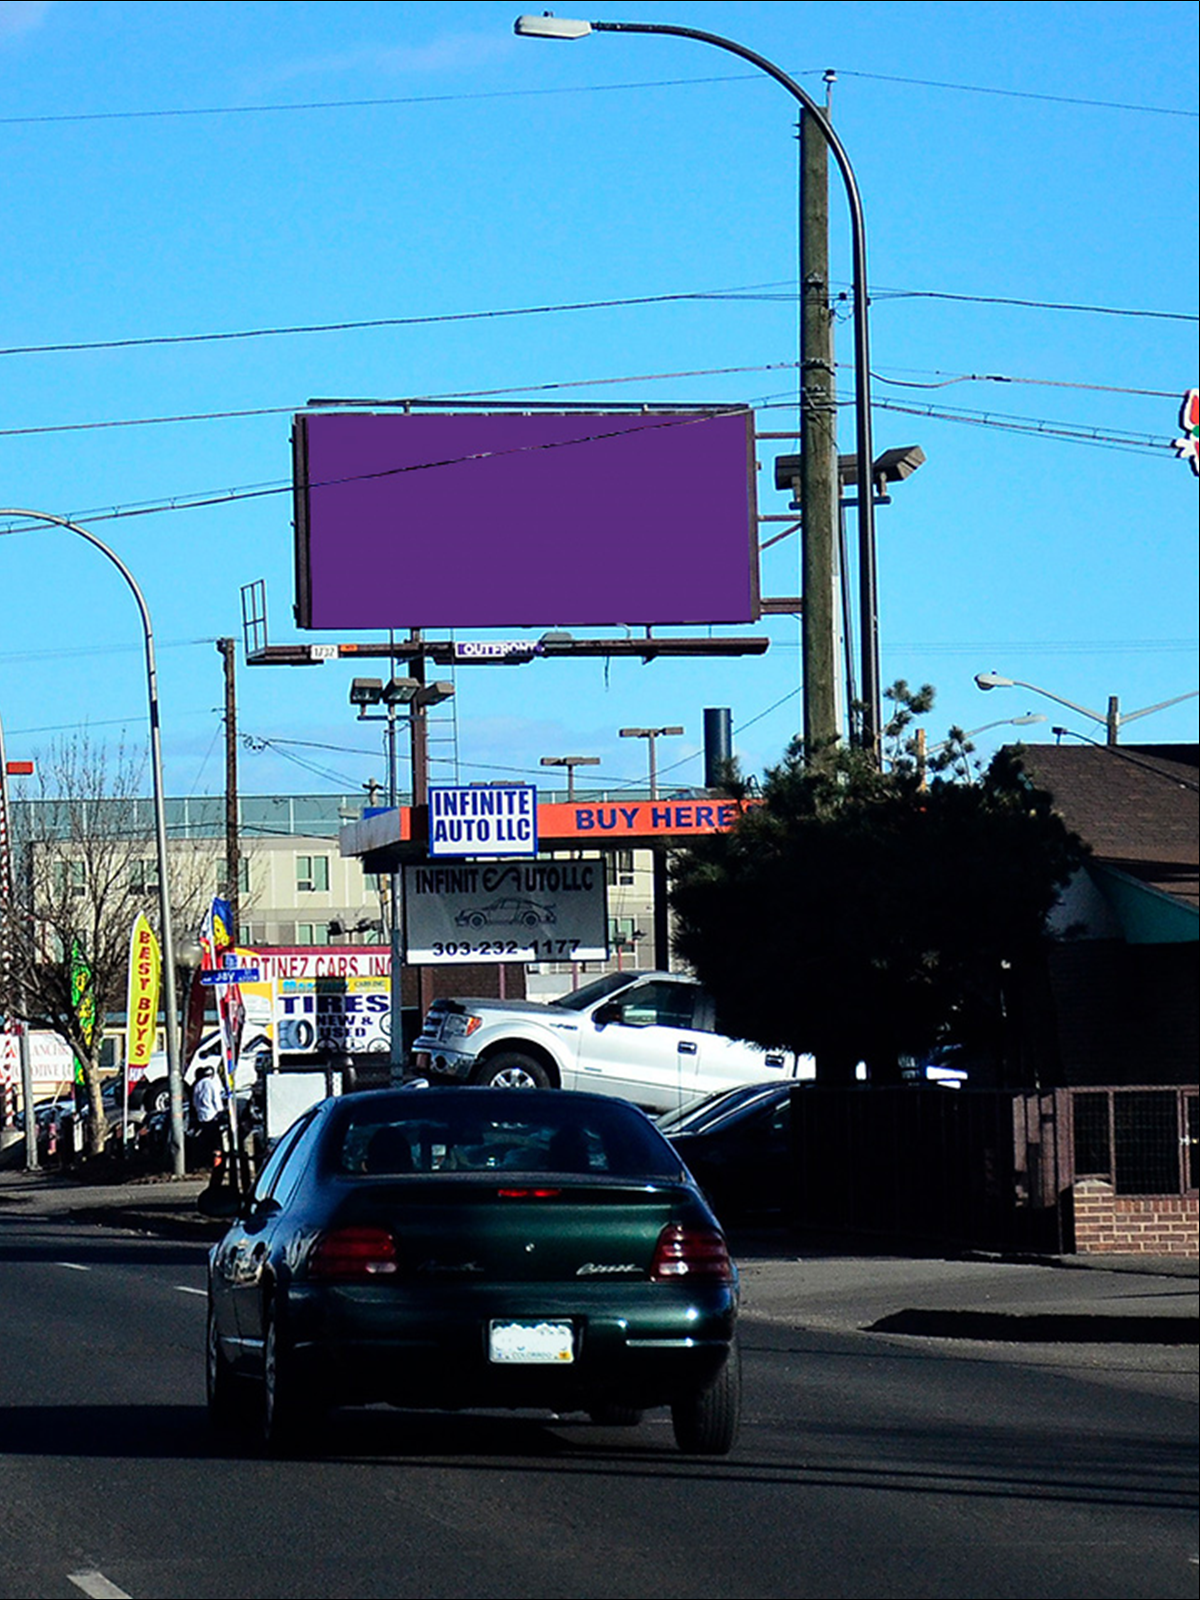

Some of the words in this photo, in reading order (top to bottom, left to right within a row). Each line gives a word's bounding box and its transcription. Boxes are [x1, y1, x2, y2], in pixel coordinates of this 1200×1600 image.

[435, 790, 529, 816] INFINITE
[434, 818, 490, 842] AUTO
[497, 817, 531, 841] LLC
[576, 808, 640, 830] BUY
[652, 805, 733, 827] HERE
[432, 938, 581, 957] 303-232-1177
[138, 931, 151, 990] BEST
[234, 956, 309, 981] ARTINEZ
[278, 994, 390, 1014] TIRES
[135, 997, 151, 1056] BUYS
[317, 1014, 356, 1026] NEW
[361, 1016, 374, 1026] &
[318, 1027, 367, 1038] USED
